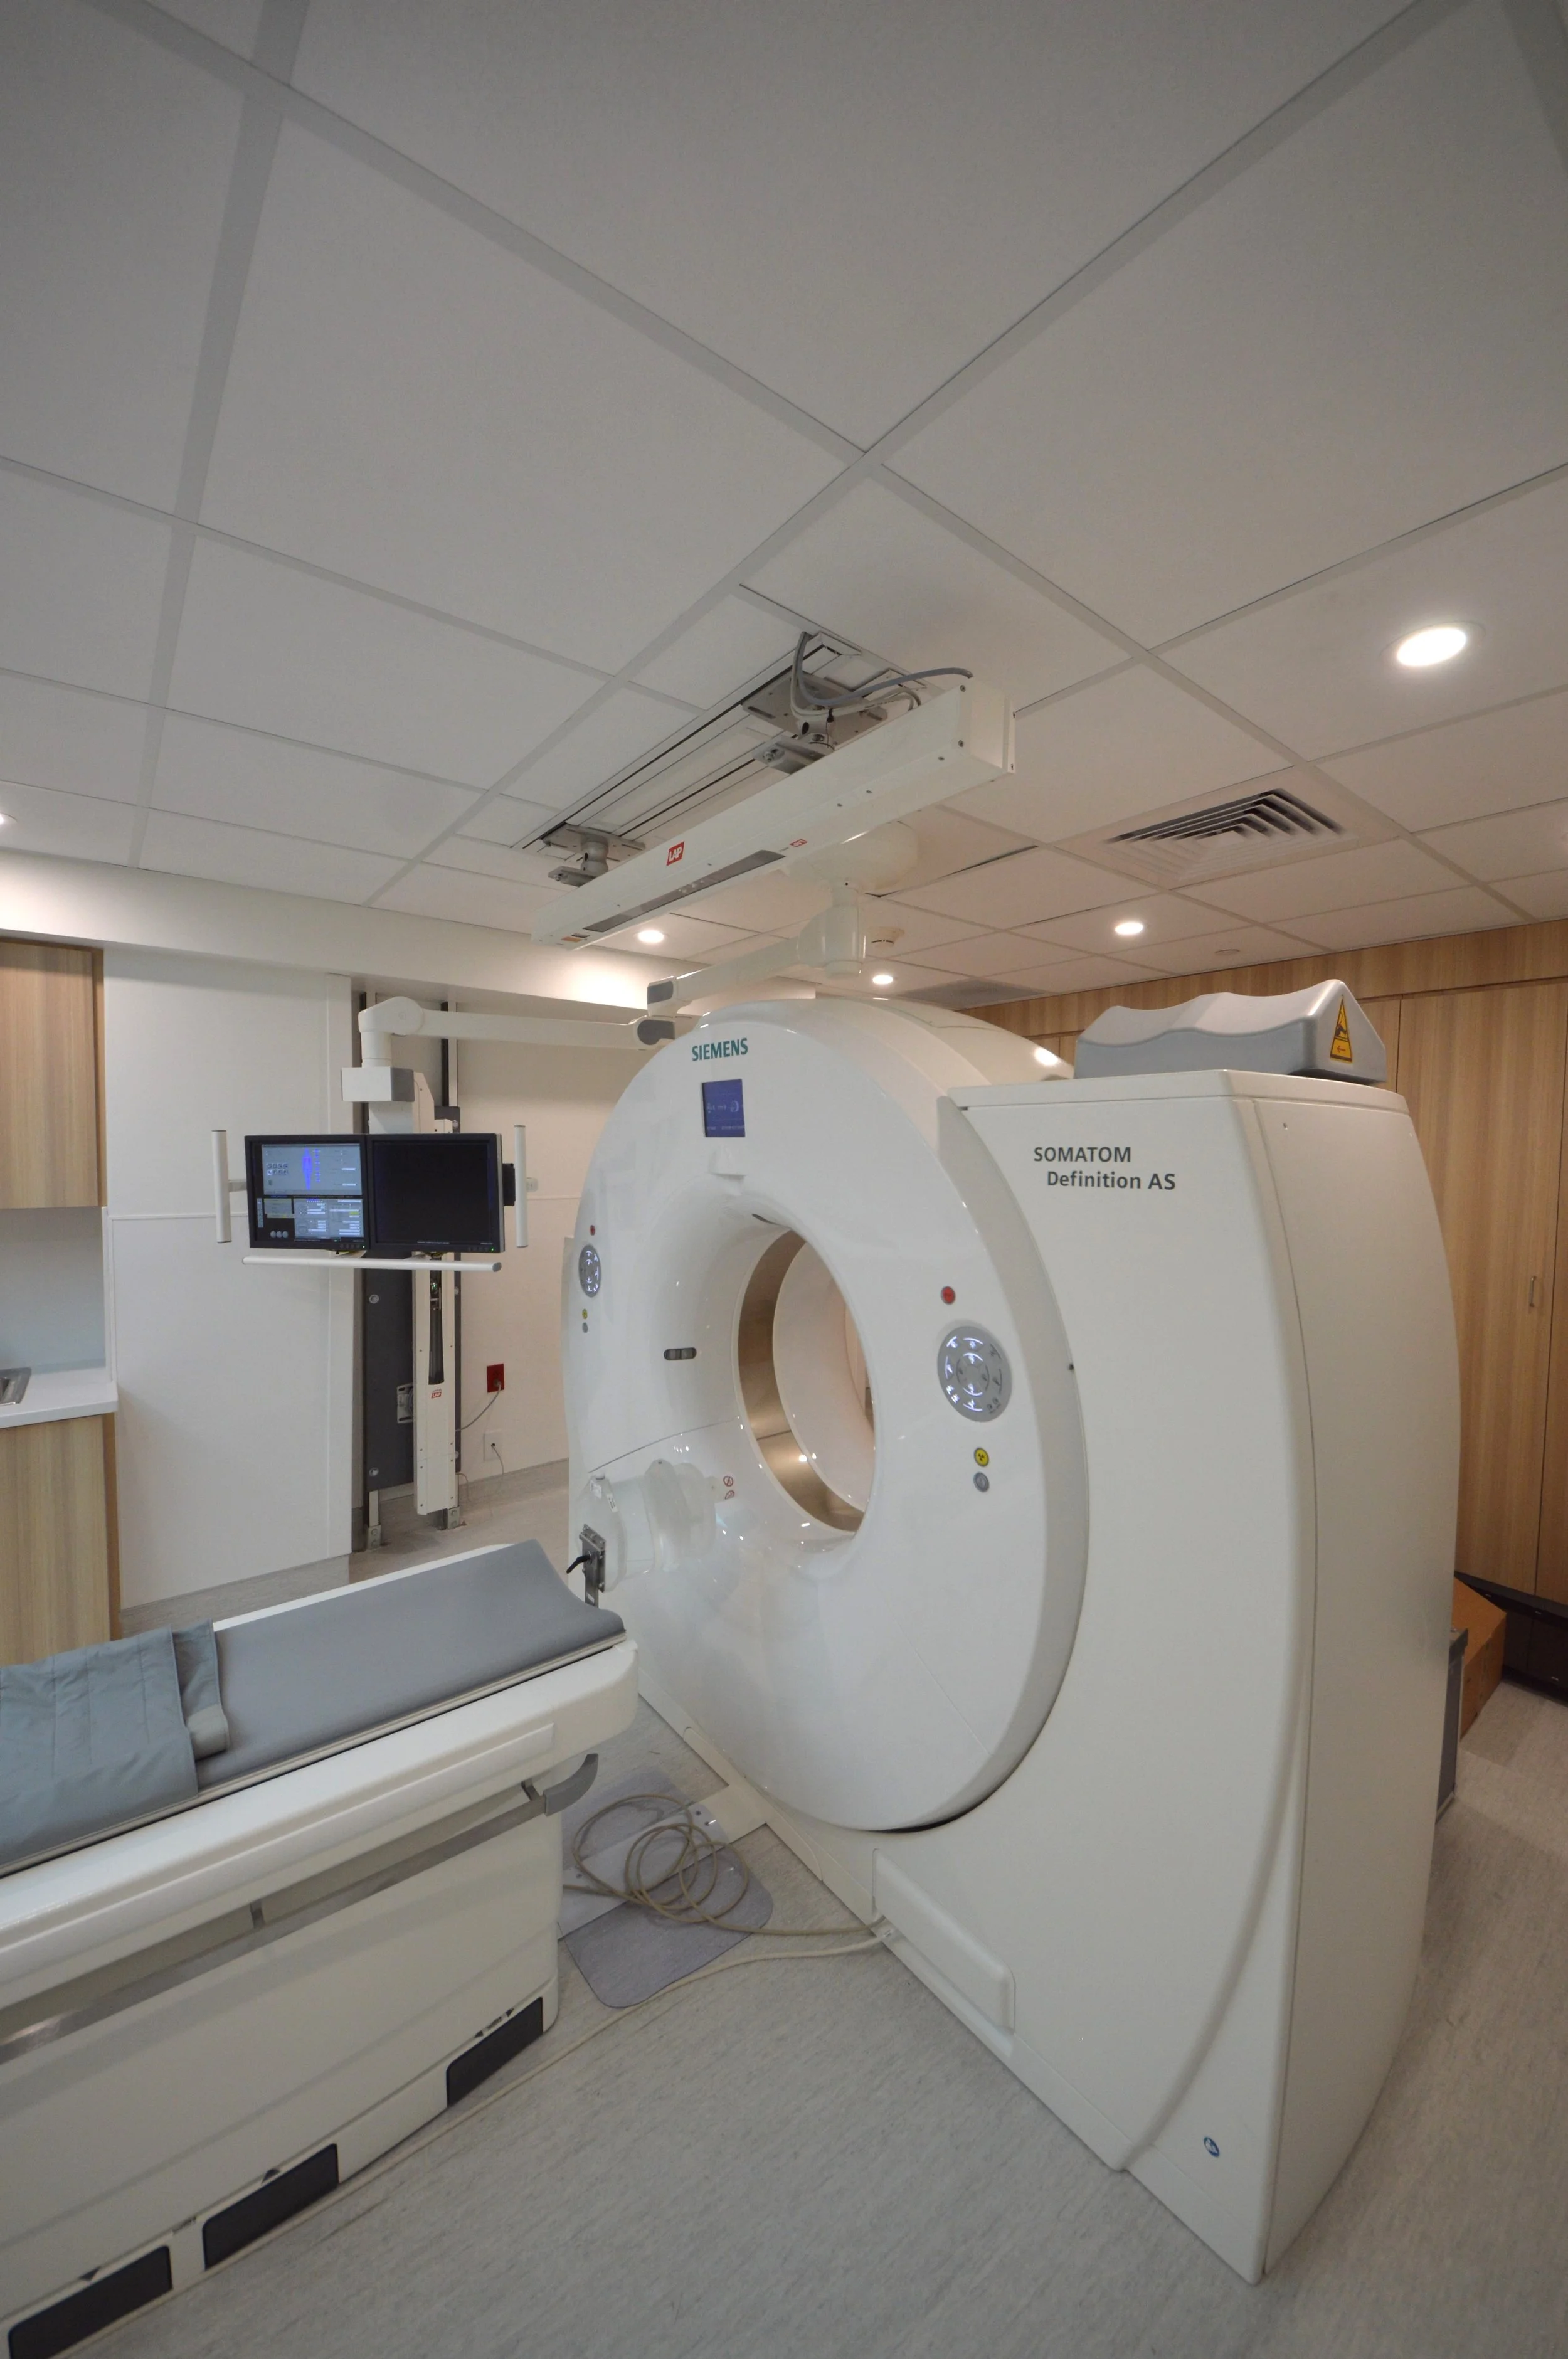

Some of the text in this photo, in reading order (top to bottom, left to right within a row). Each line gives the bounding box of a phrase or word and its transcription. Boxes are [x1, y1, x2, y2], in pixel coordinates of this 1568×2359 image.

[668, 845, 683, 862] LAP
[692, 1037, 748, 1061] SIEMENS
[1034, 1146, 1131, 1162] SOMATOM
[1047, 1170, 1176, 1190] Definition AS
